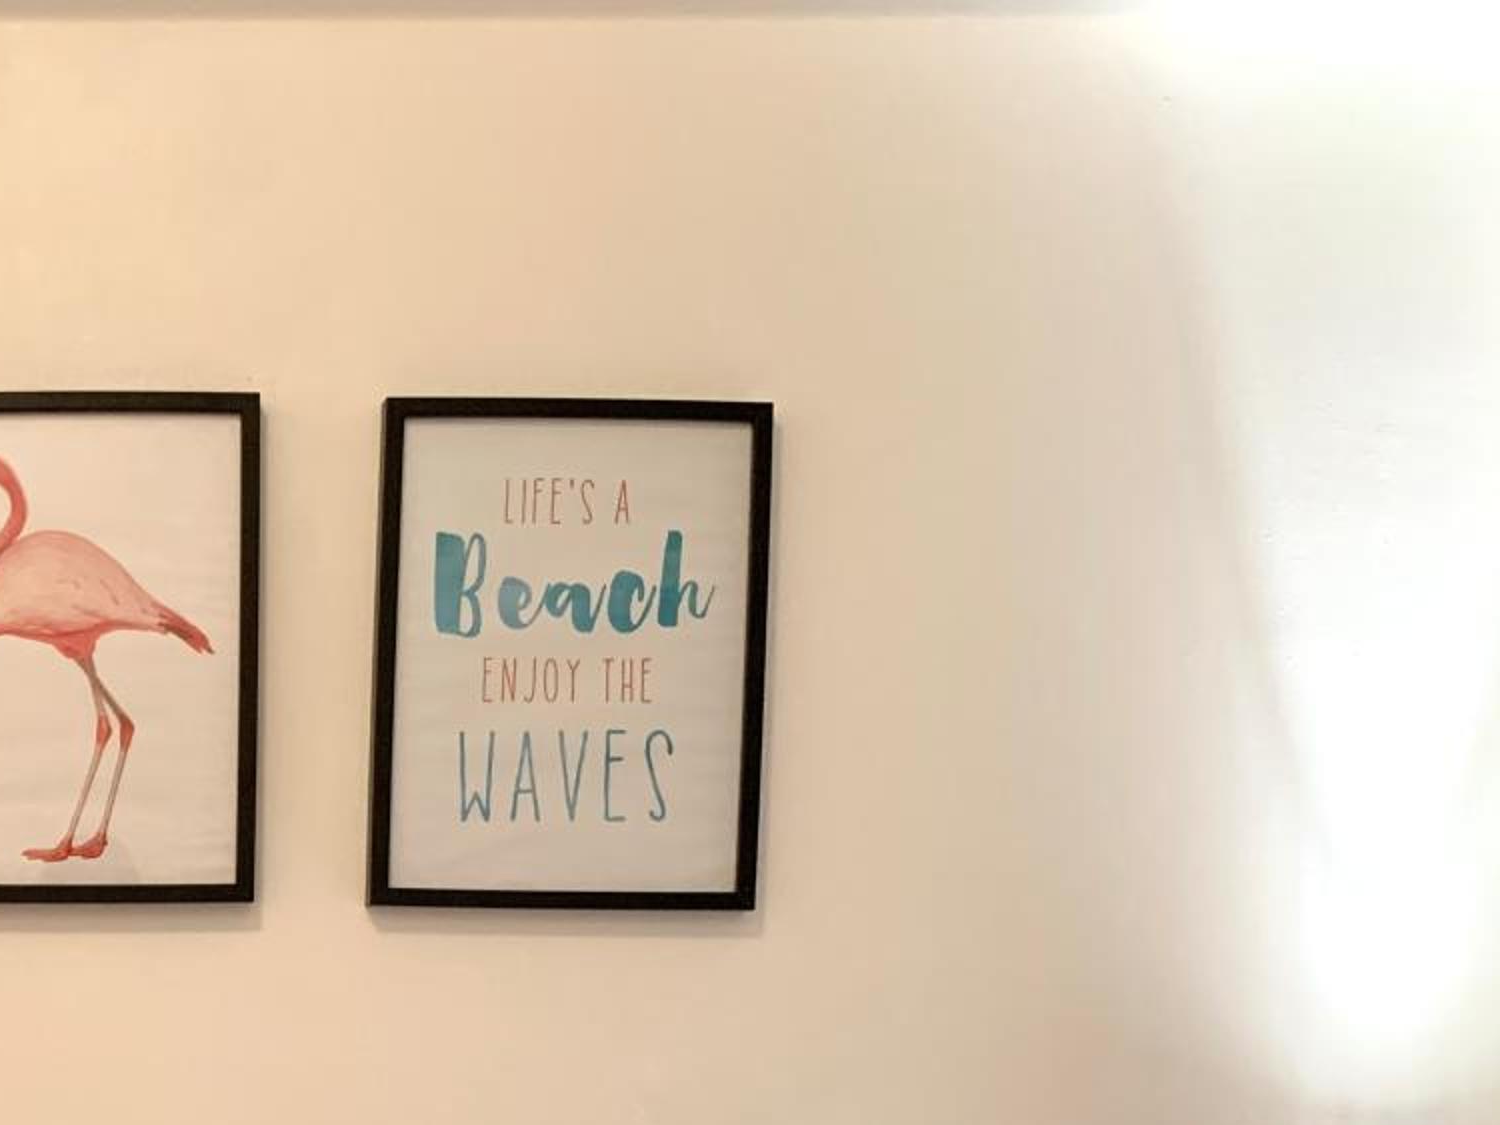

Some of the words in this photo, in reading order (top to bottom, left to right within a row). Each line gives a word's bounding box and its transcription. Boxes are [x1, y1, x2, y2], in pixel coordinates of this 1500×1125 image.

[504, 477, 596, 525] LIFE'S
[614, 479, 632, 525] A
[433, 529, 716, 639] Beach
[481, 656, 581, 704] ENJOY
[602, 656, 653, 704] THE
[458, 729, 675, 823] WAVES
